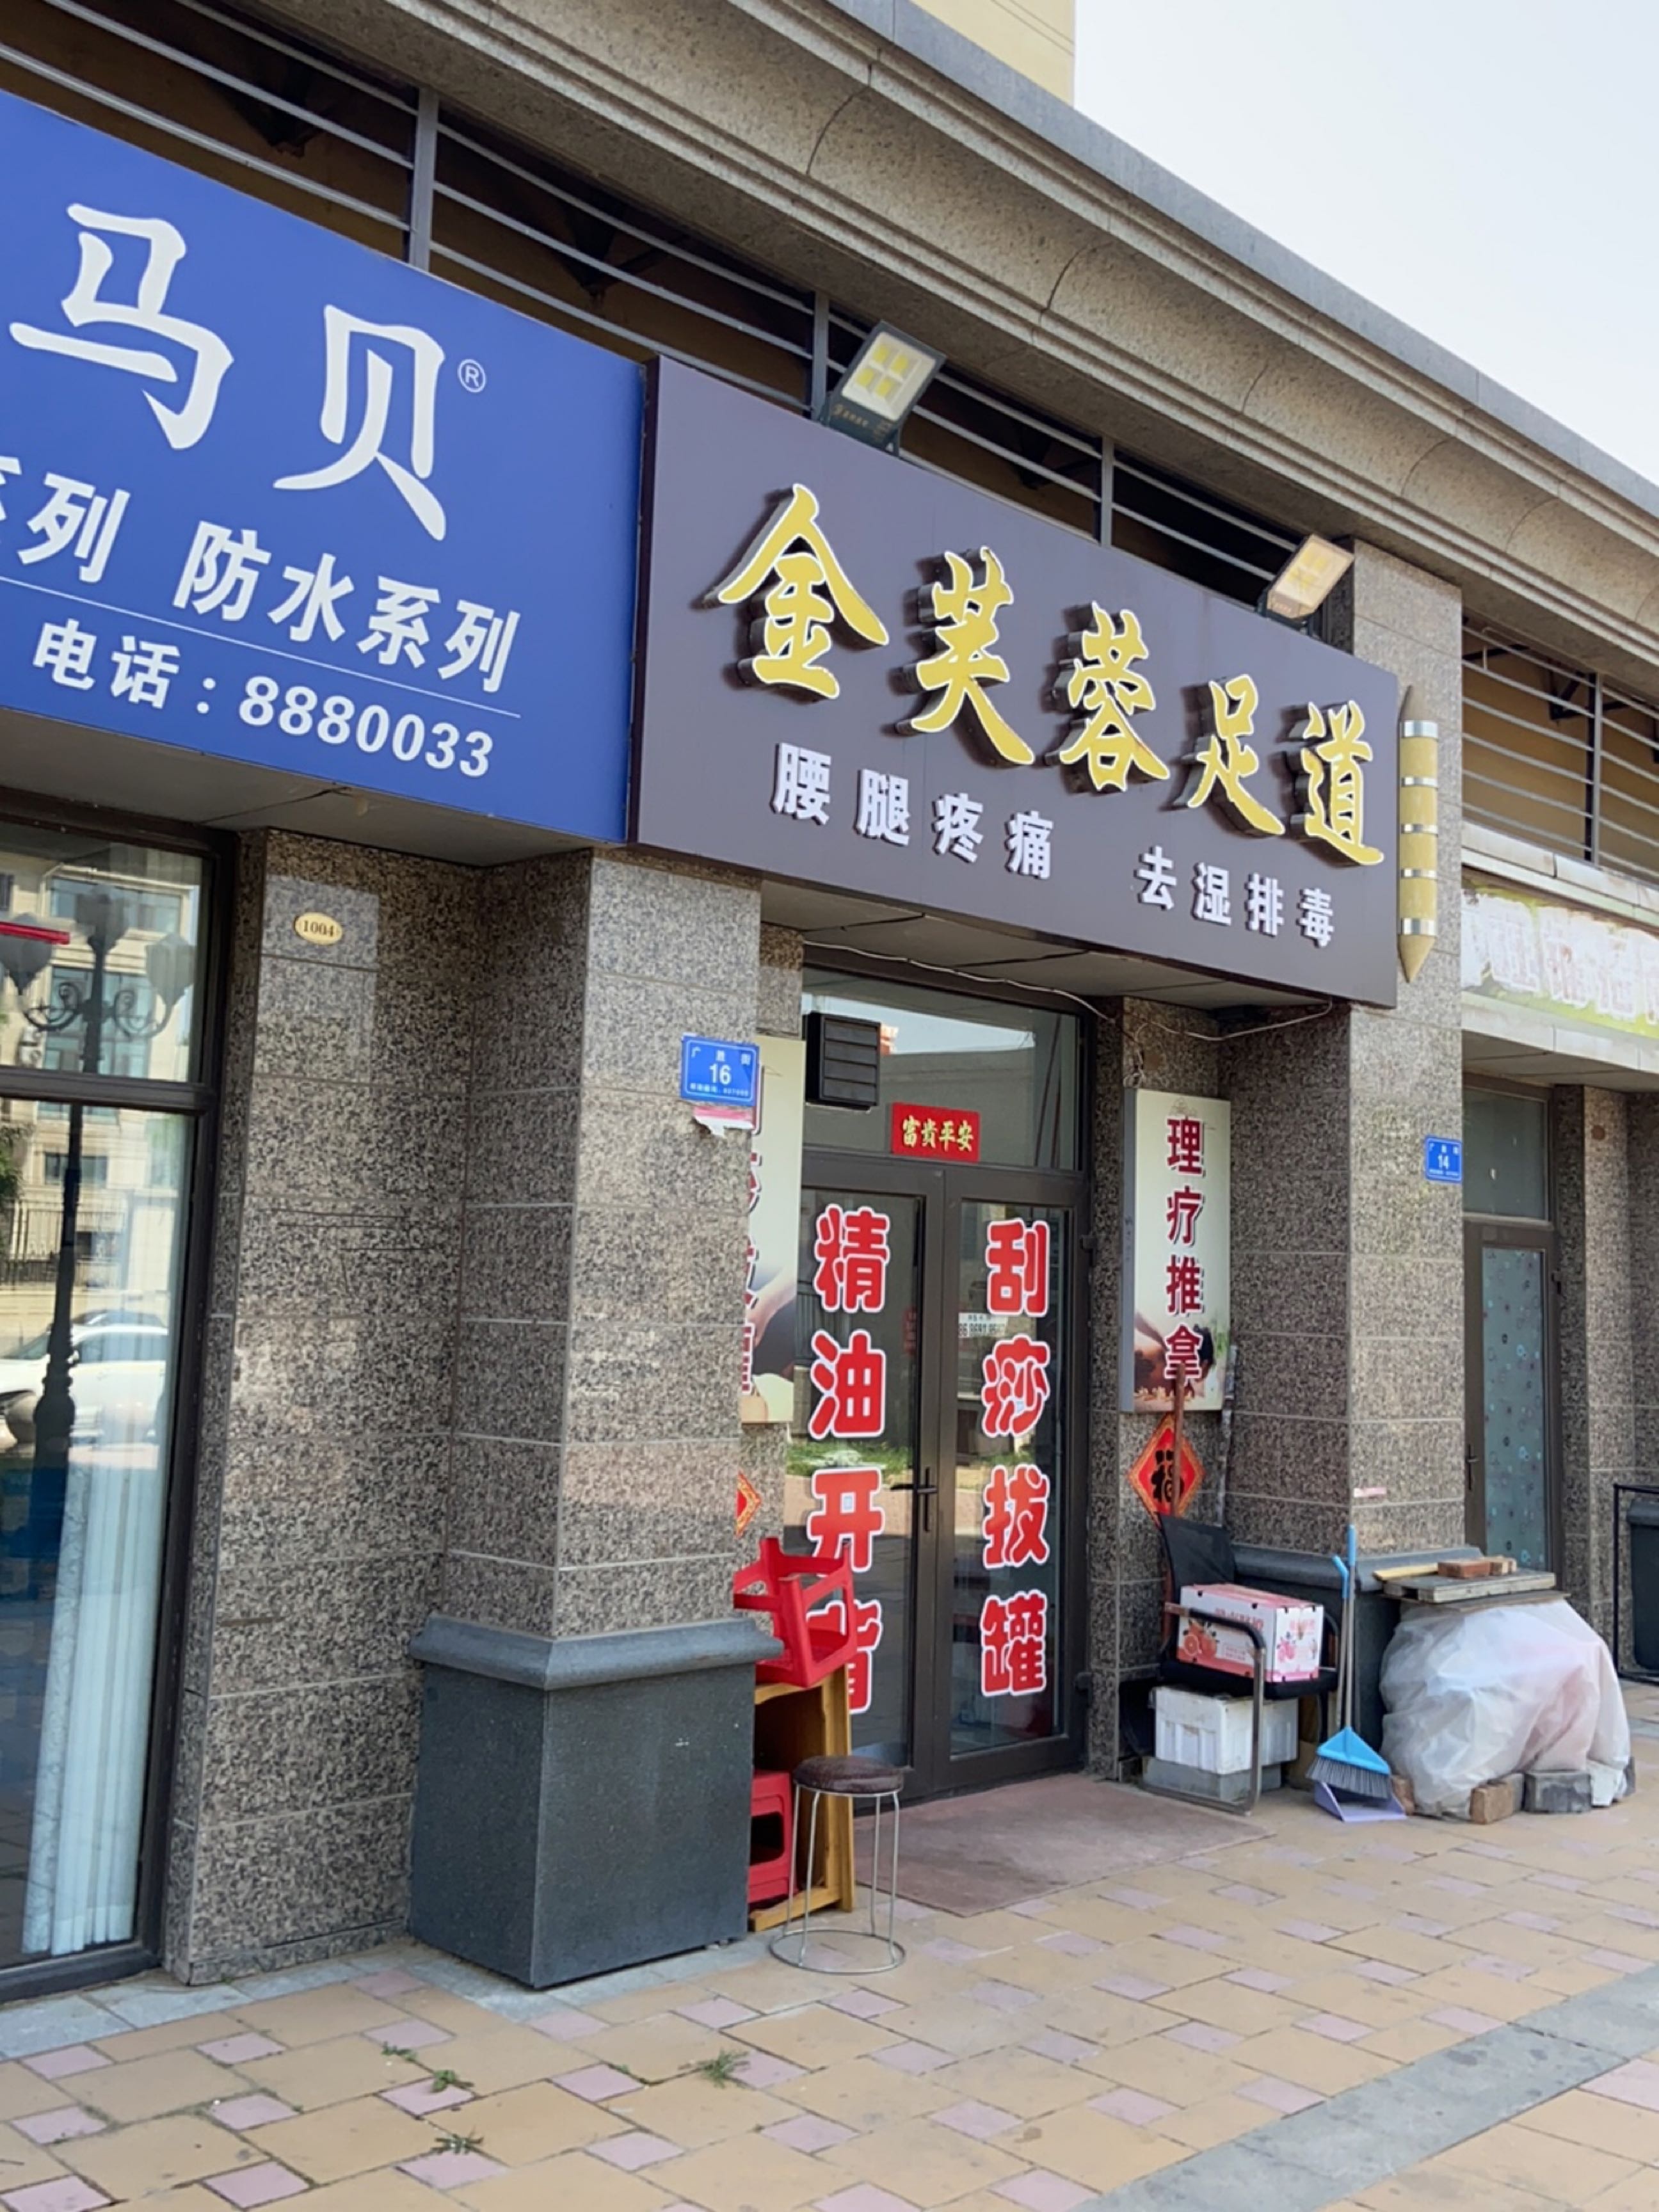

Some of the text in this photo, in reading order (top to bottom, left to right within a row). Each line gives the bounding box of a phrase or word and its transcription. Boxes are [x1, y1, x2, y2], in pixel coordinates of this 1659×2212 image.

[10, 204, 446, 541] 马贝
[173, 520, 520, 694] 防水系列
[717, 483, 1385, 867] 金芙蓉足道
[772, 741, 1335, 949] 腰腿疼痛 去湿排毒
[709, 1062, 732, 1085] 16
[902, 1114, 974, 1151] 富贵平安
[1164, 1116, 1204, 1386] 理疗推拿
[981, 1219, 1050, 1696] 刮痧拔罐
